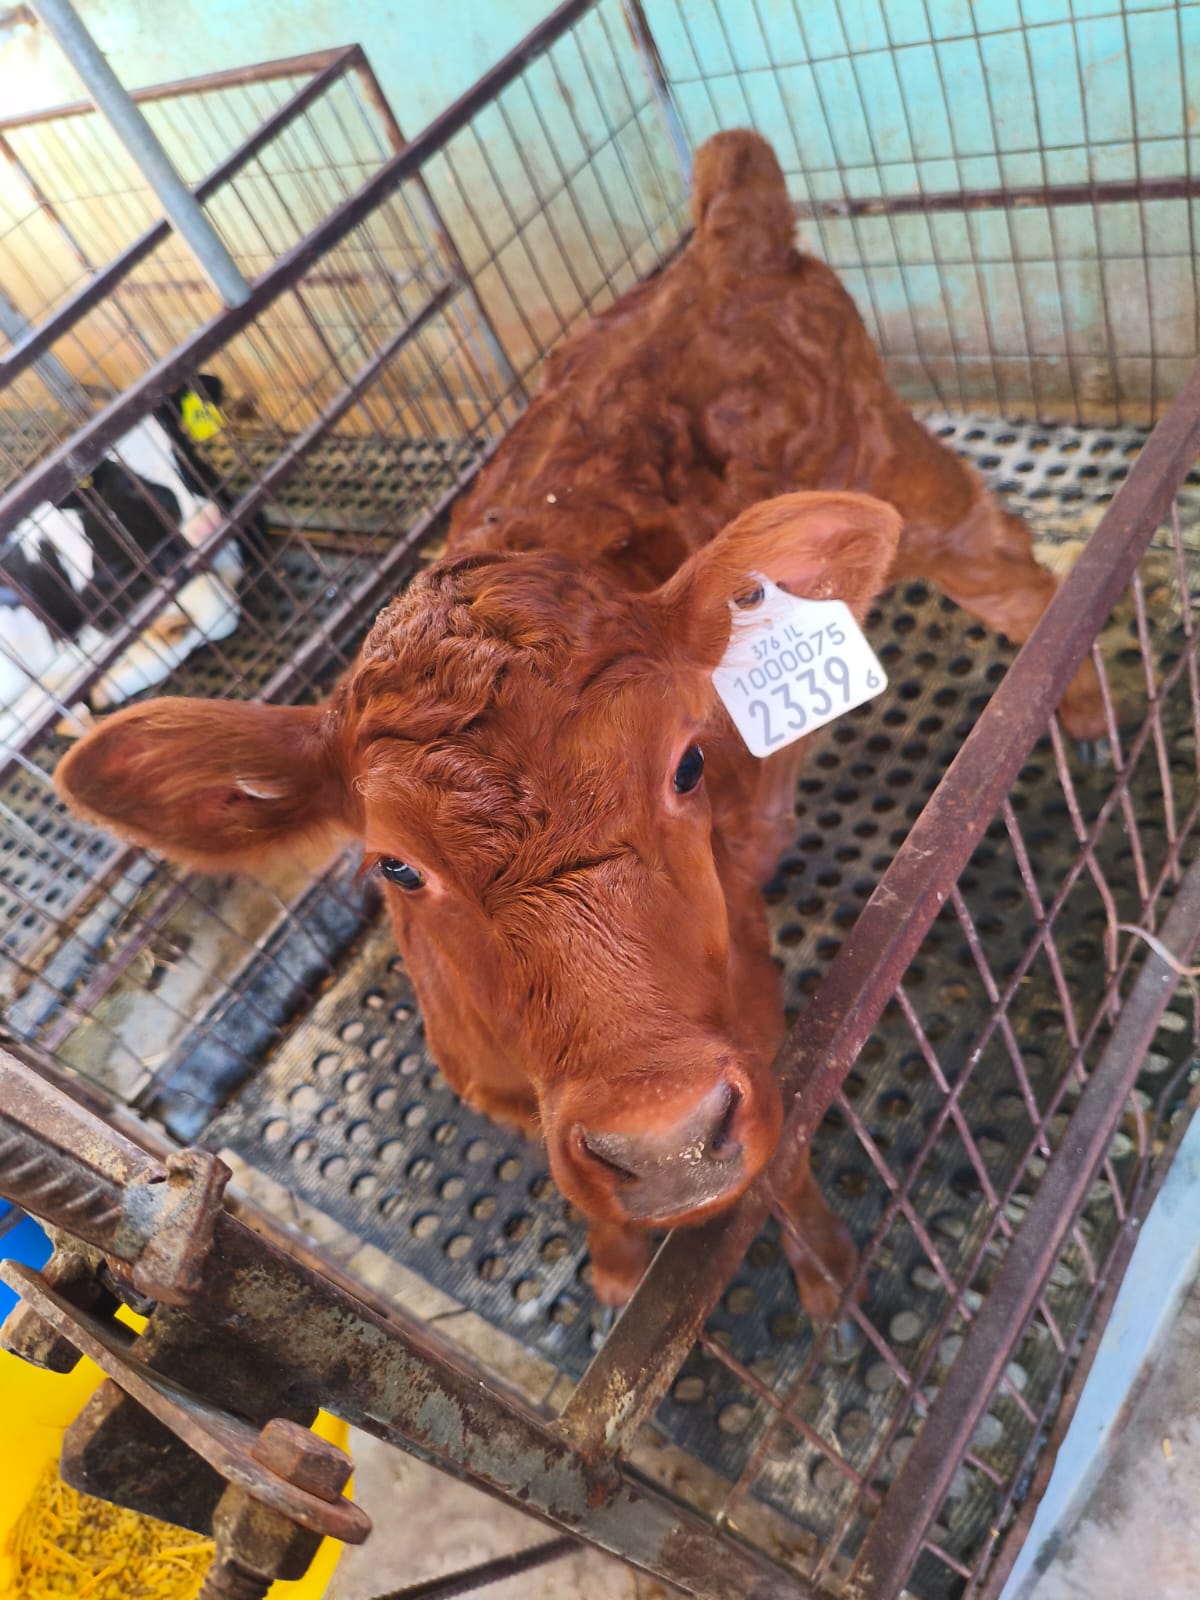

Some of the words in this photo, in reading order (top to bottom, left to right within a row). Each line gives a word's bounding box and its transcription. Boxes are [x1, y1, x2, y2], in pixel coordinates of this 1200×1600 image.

[734, 622, 846, 696] 1000075
[752, 636, 780, 660] 376
[783, 625, 803, 642] IL
[748, 656, 850, 747] 2339
[866, 669, 880, 689] 6
